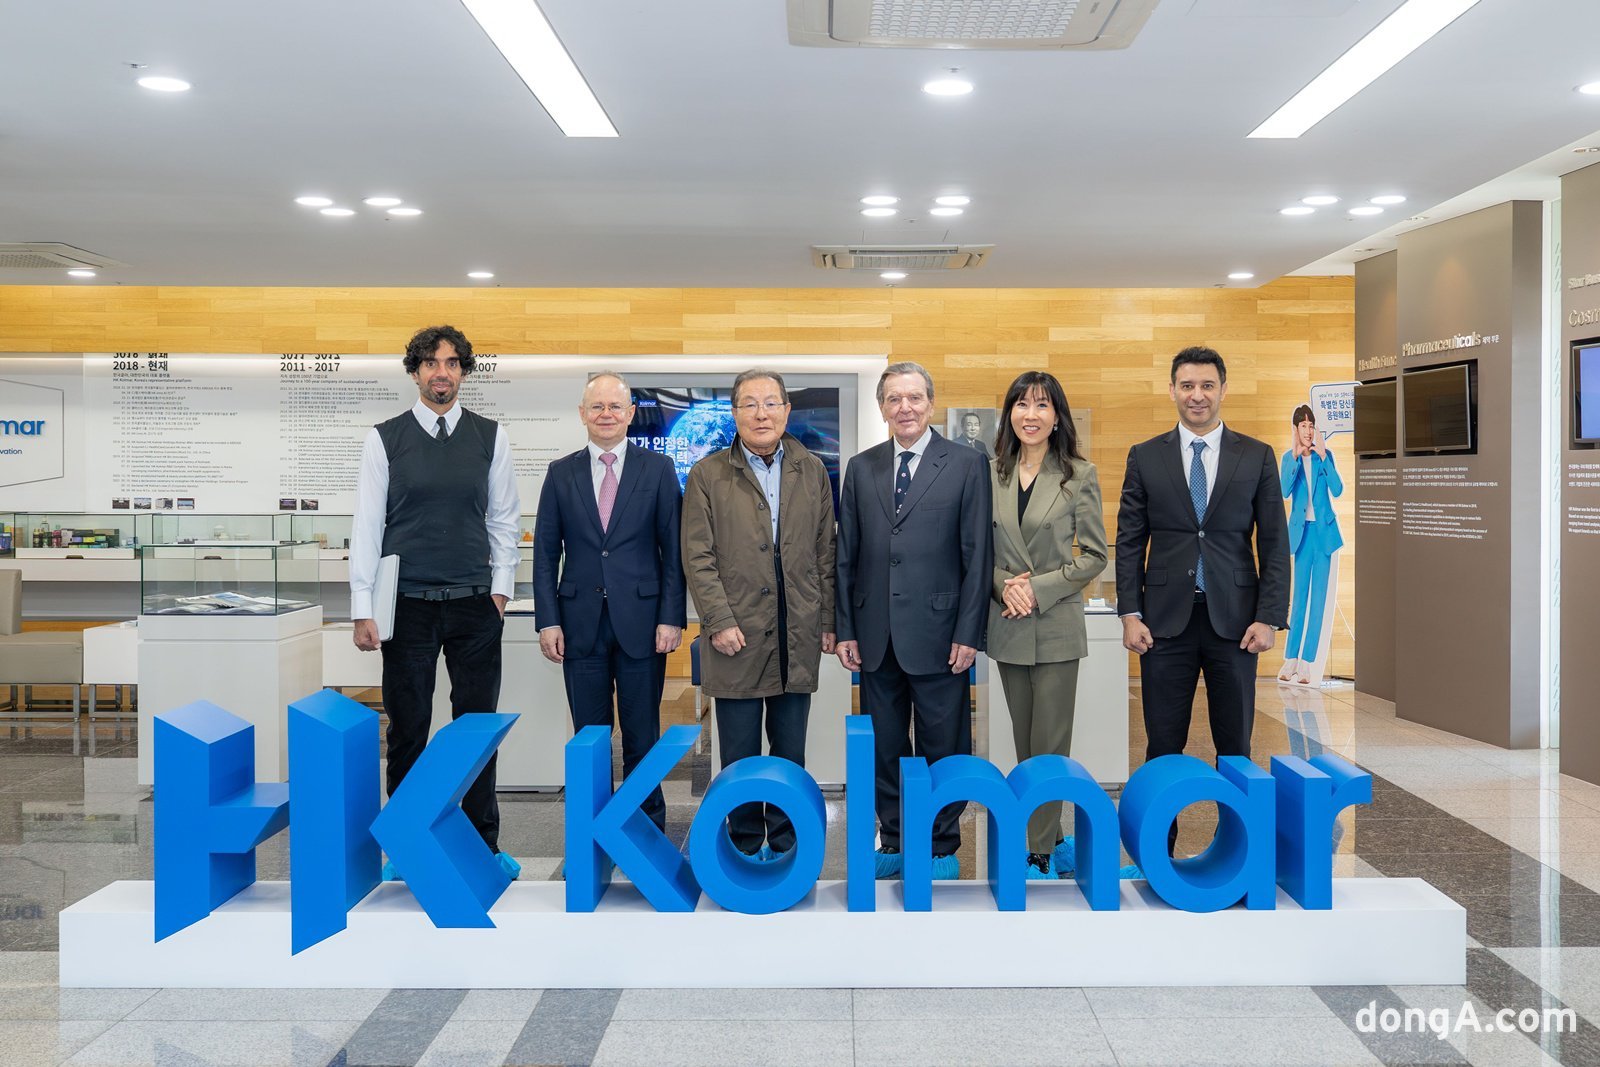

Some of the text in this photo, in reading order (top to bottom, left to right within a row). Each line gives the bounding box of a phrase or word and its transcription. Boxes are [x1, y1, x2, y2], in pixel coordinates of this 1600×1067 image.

[1402, 331, 1481, 356] Pharmaceuticals
[113, 361, 139, 371] 2018
[148, 360, 169, 372] 현재
[280, 362, 306, 372] 2011
[314, 362, 340, 372] 2017
[1321, 400, 1338, 410] 특별한
[1327, 410, 1352, 421] 응원해요!
[0, 420, 45, 436] mar
[652, 437, 689, 451] 인정한
[565, 714, 1373, 915] Kolmar
